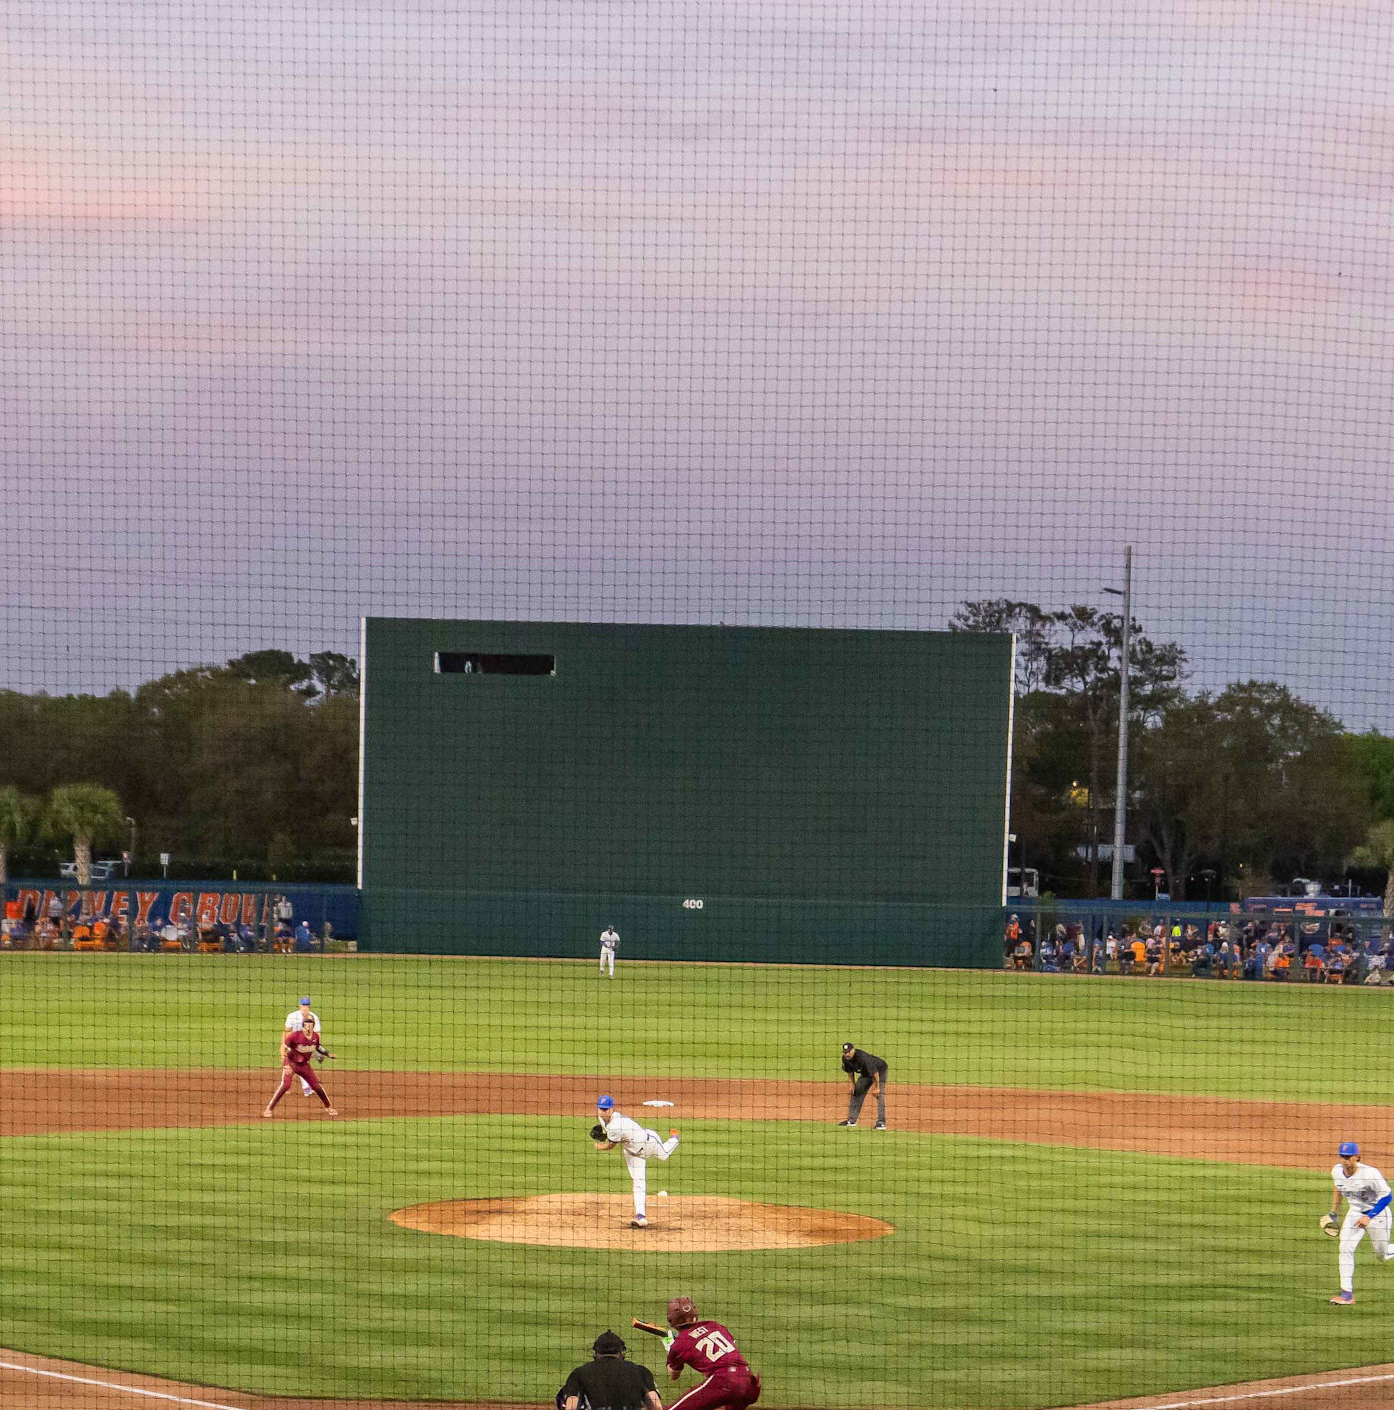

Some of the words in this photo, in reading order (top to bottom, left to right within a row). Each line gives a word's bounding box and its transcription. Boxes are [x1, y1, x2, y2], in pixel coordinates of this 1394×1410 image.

[683, 899, 704, 909] 400
[688, 1326, 709, 1340] WEST
[695, 1330, 736, 1363] 20
